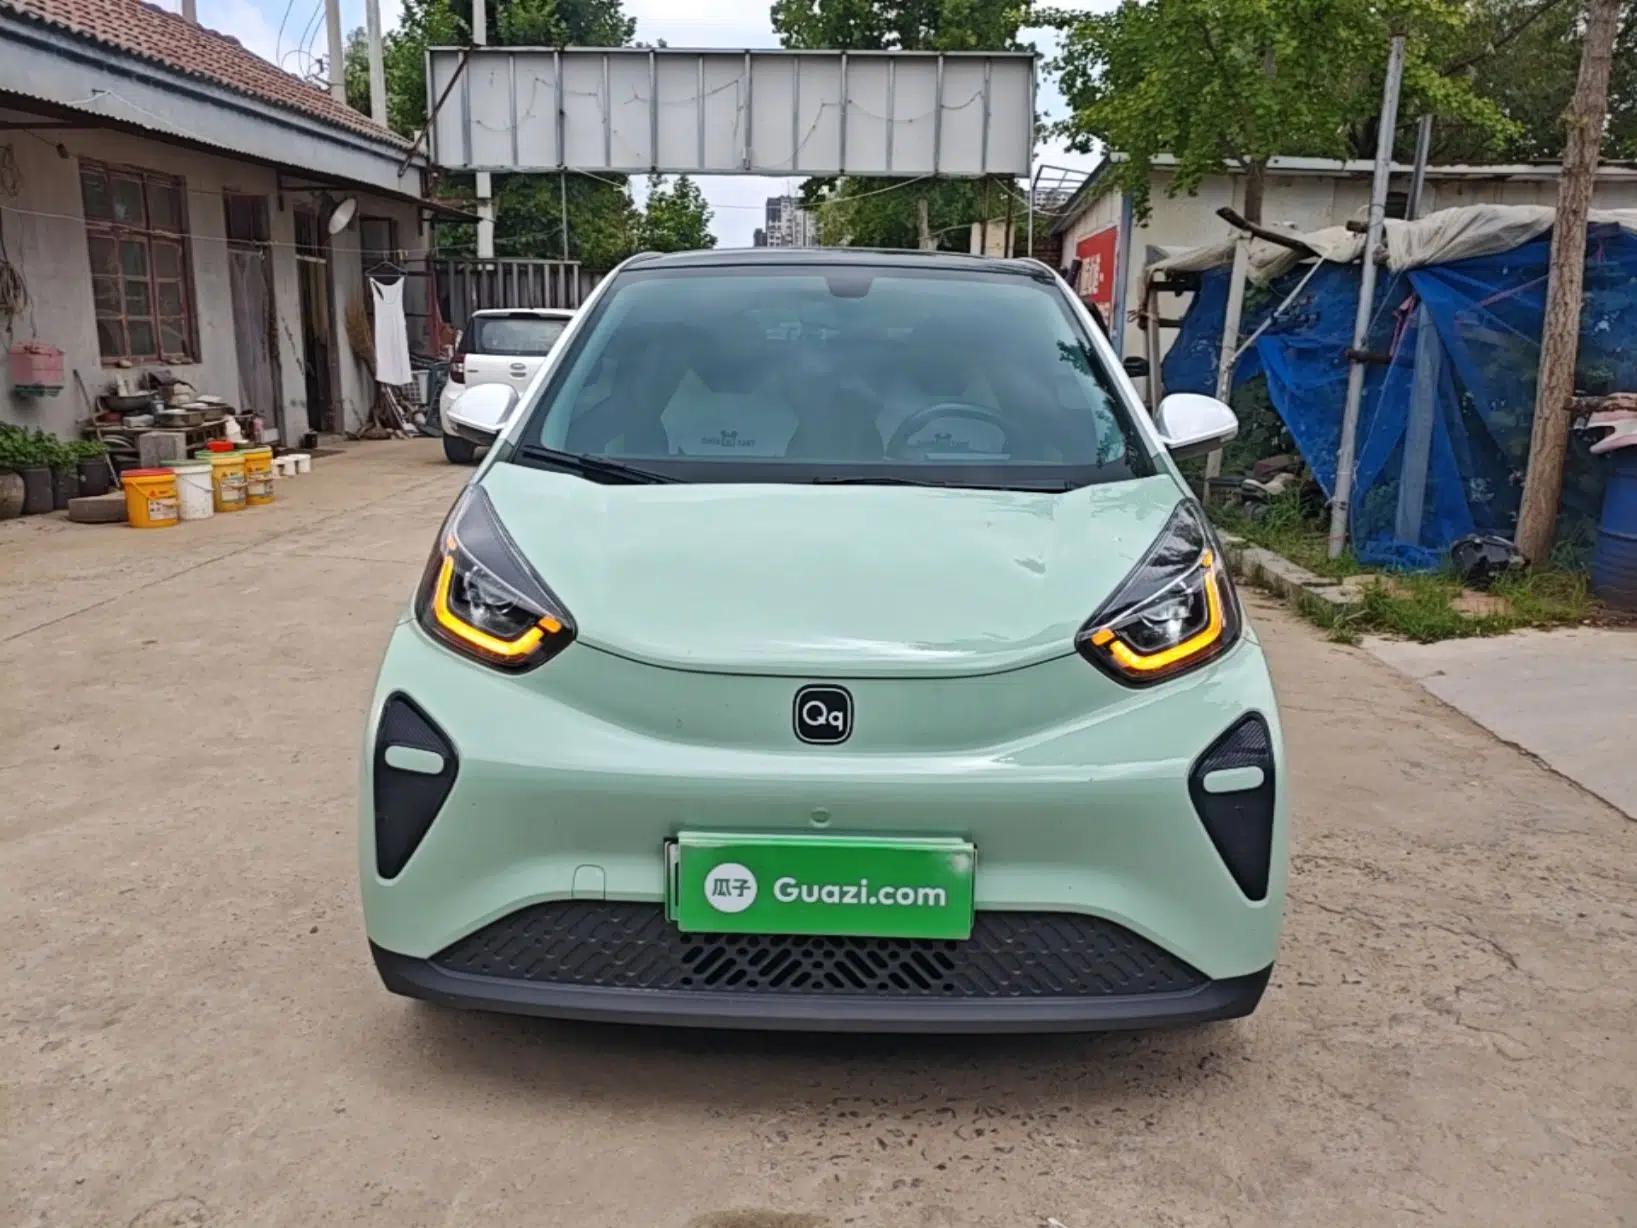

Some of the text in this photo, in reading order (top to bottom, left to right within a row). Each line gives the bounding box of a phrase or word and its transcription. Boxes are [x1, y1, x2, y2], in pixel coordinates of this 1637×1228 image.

[802, 700, 844, 732] Qq
[711, 878, 751, 898] 瓜子
[773, 877, 947, 907] Guazi.com
